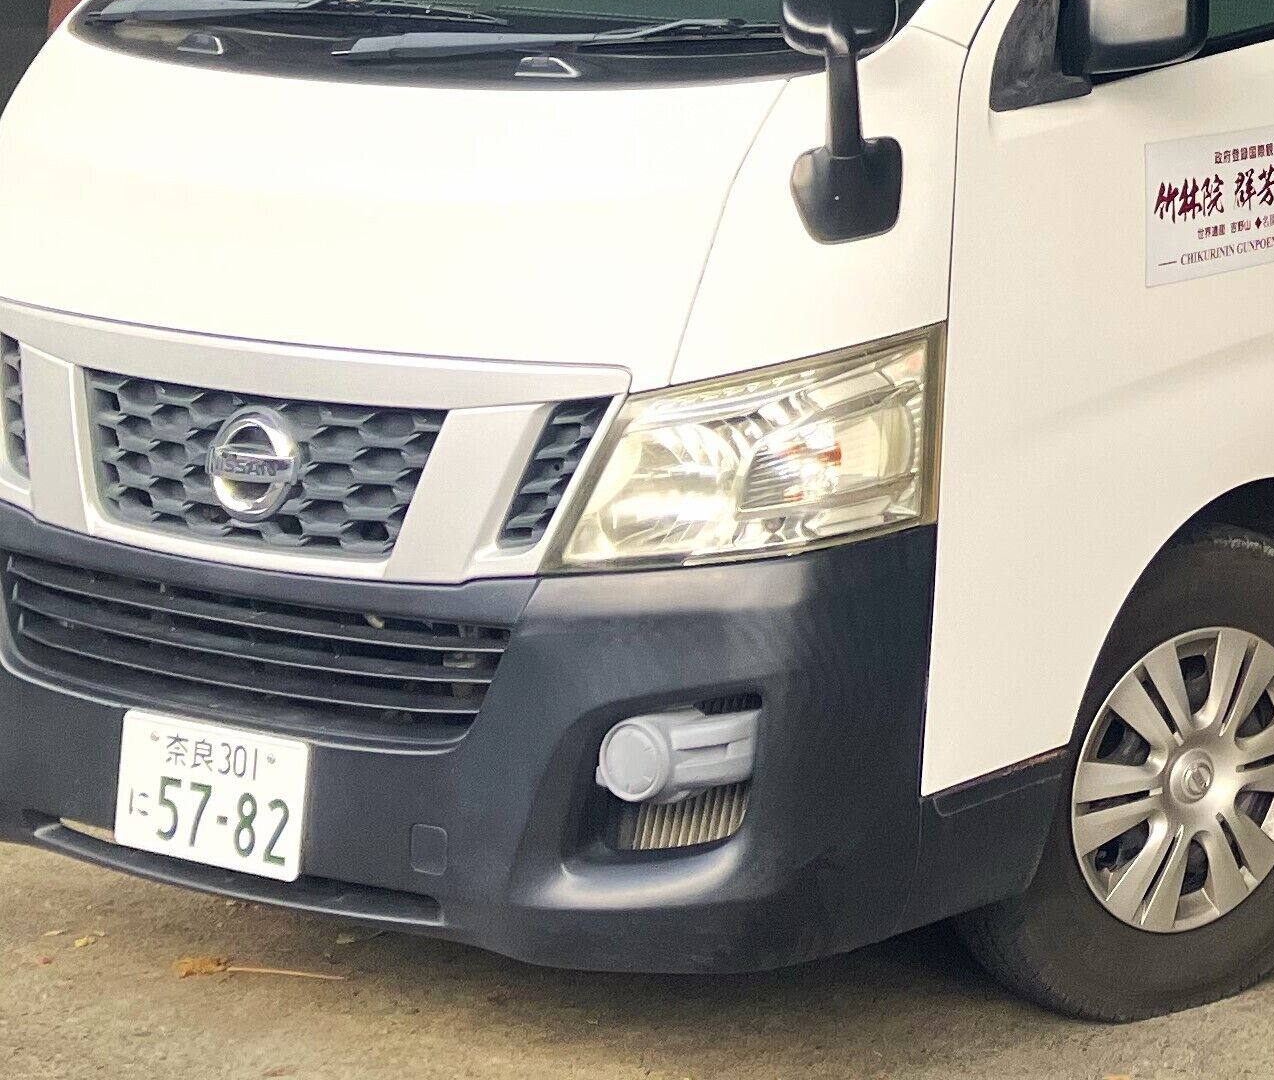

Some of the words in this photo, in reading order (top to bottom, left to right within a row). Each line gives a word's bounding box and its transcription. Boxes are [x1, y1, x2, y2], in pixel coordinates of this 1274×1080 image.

[1154, 173, 1224, 223] 竹林院
[1180, 245, 1235, 266] CHIKURININ
[129, 788, 149, 816] に
[156, 775, 290, 867] 57-82
